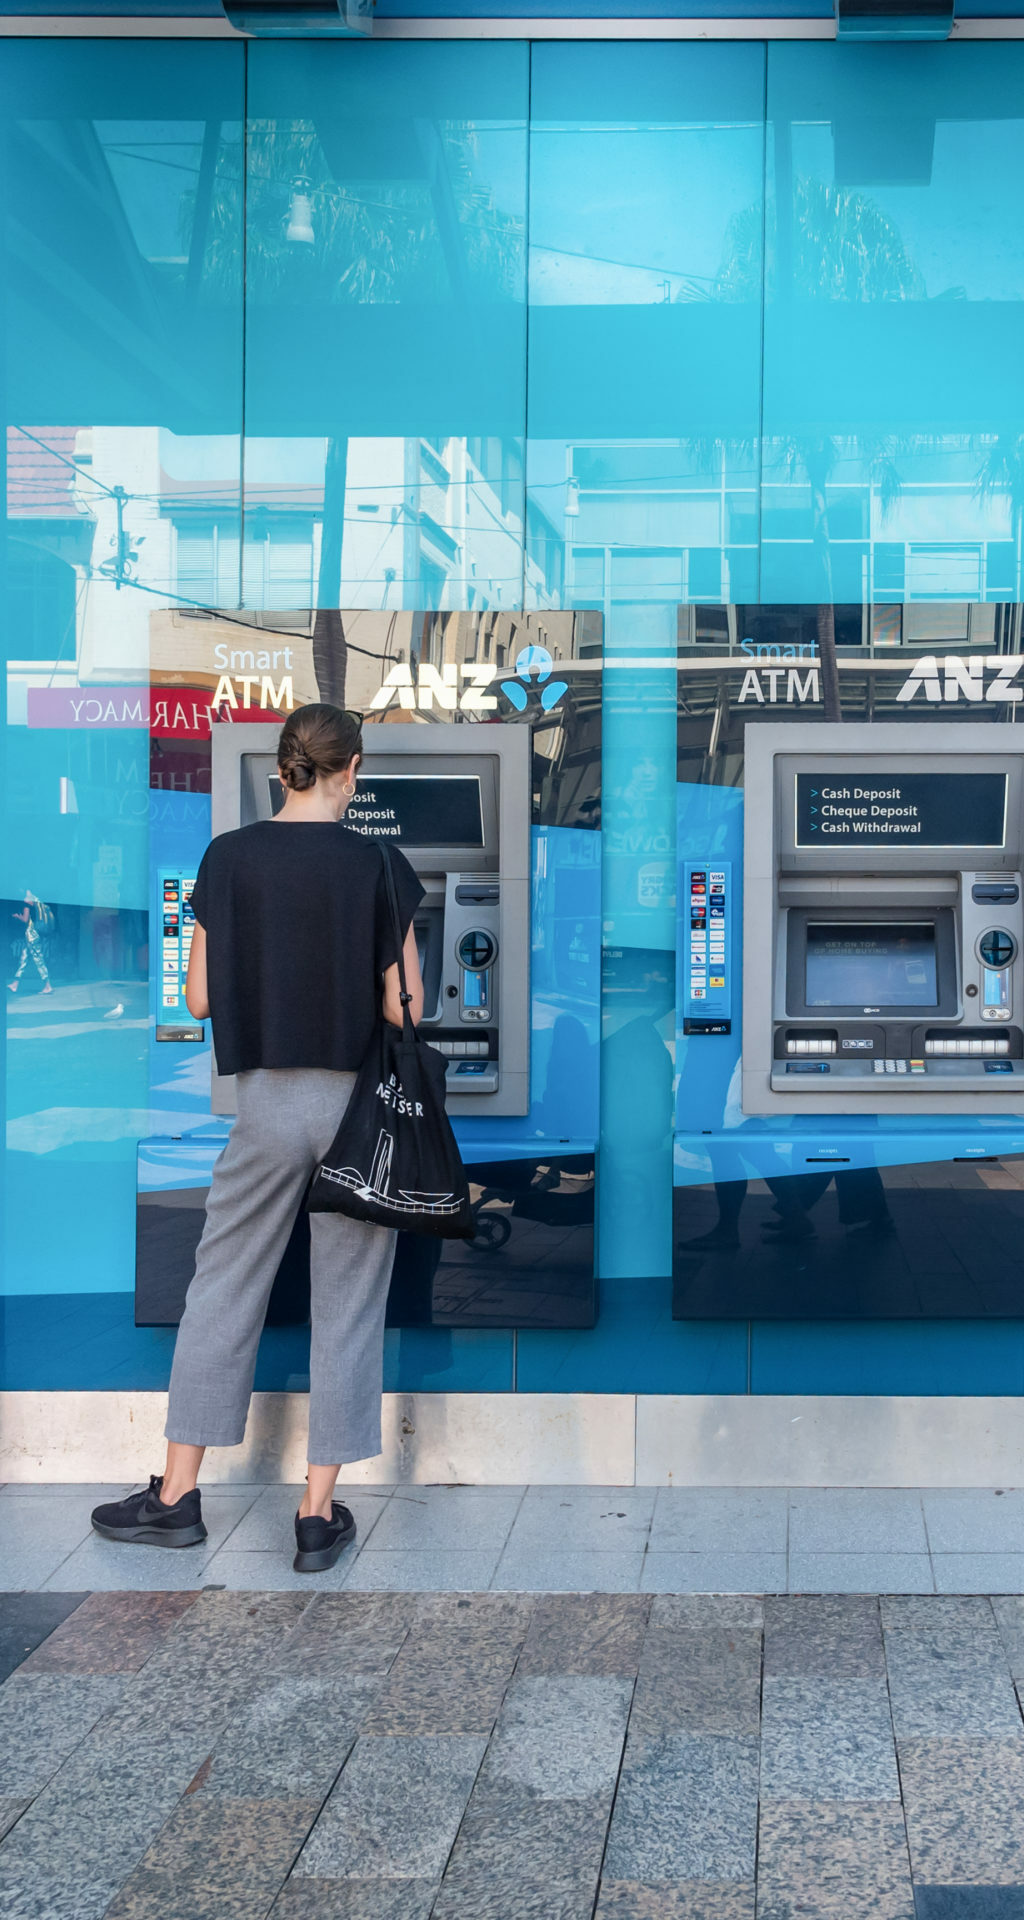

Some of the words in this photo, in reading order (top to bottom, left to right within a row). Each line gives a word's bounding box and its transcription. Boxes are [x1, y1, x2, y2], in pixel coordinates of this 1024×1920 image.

[213, 643, 293, 670] Smart
[740, 638, 820, 664] Smart
[369, 662, 498, 710] ANZ
[738, 669, 820, 703] ATM
[895, 655, 1023, 702] ANZ
[210, 675, 294, 709] ATM
[821, 788, 851, 799] Cash
[854, 788, 901, 801] Deposit
[348, 808, 396, 821] Deposit
[821, 805, 868, 818] Cheque
[871, 805, 918, 818] Deposit
[821, 822, 850, 832] Cash
[852, 822, 921, 833] Withdrawal
